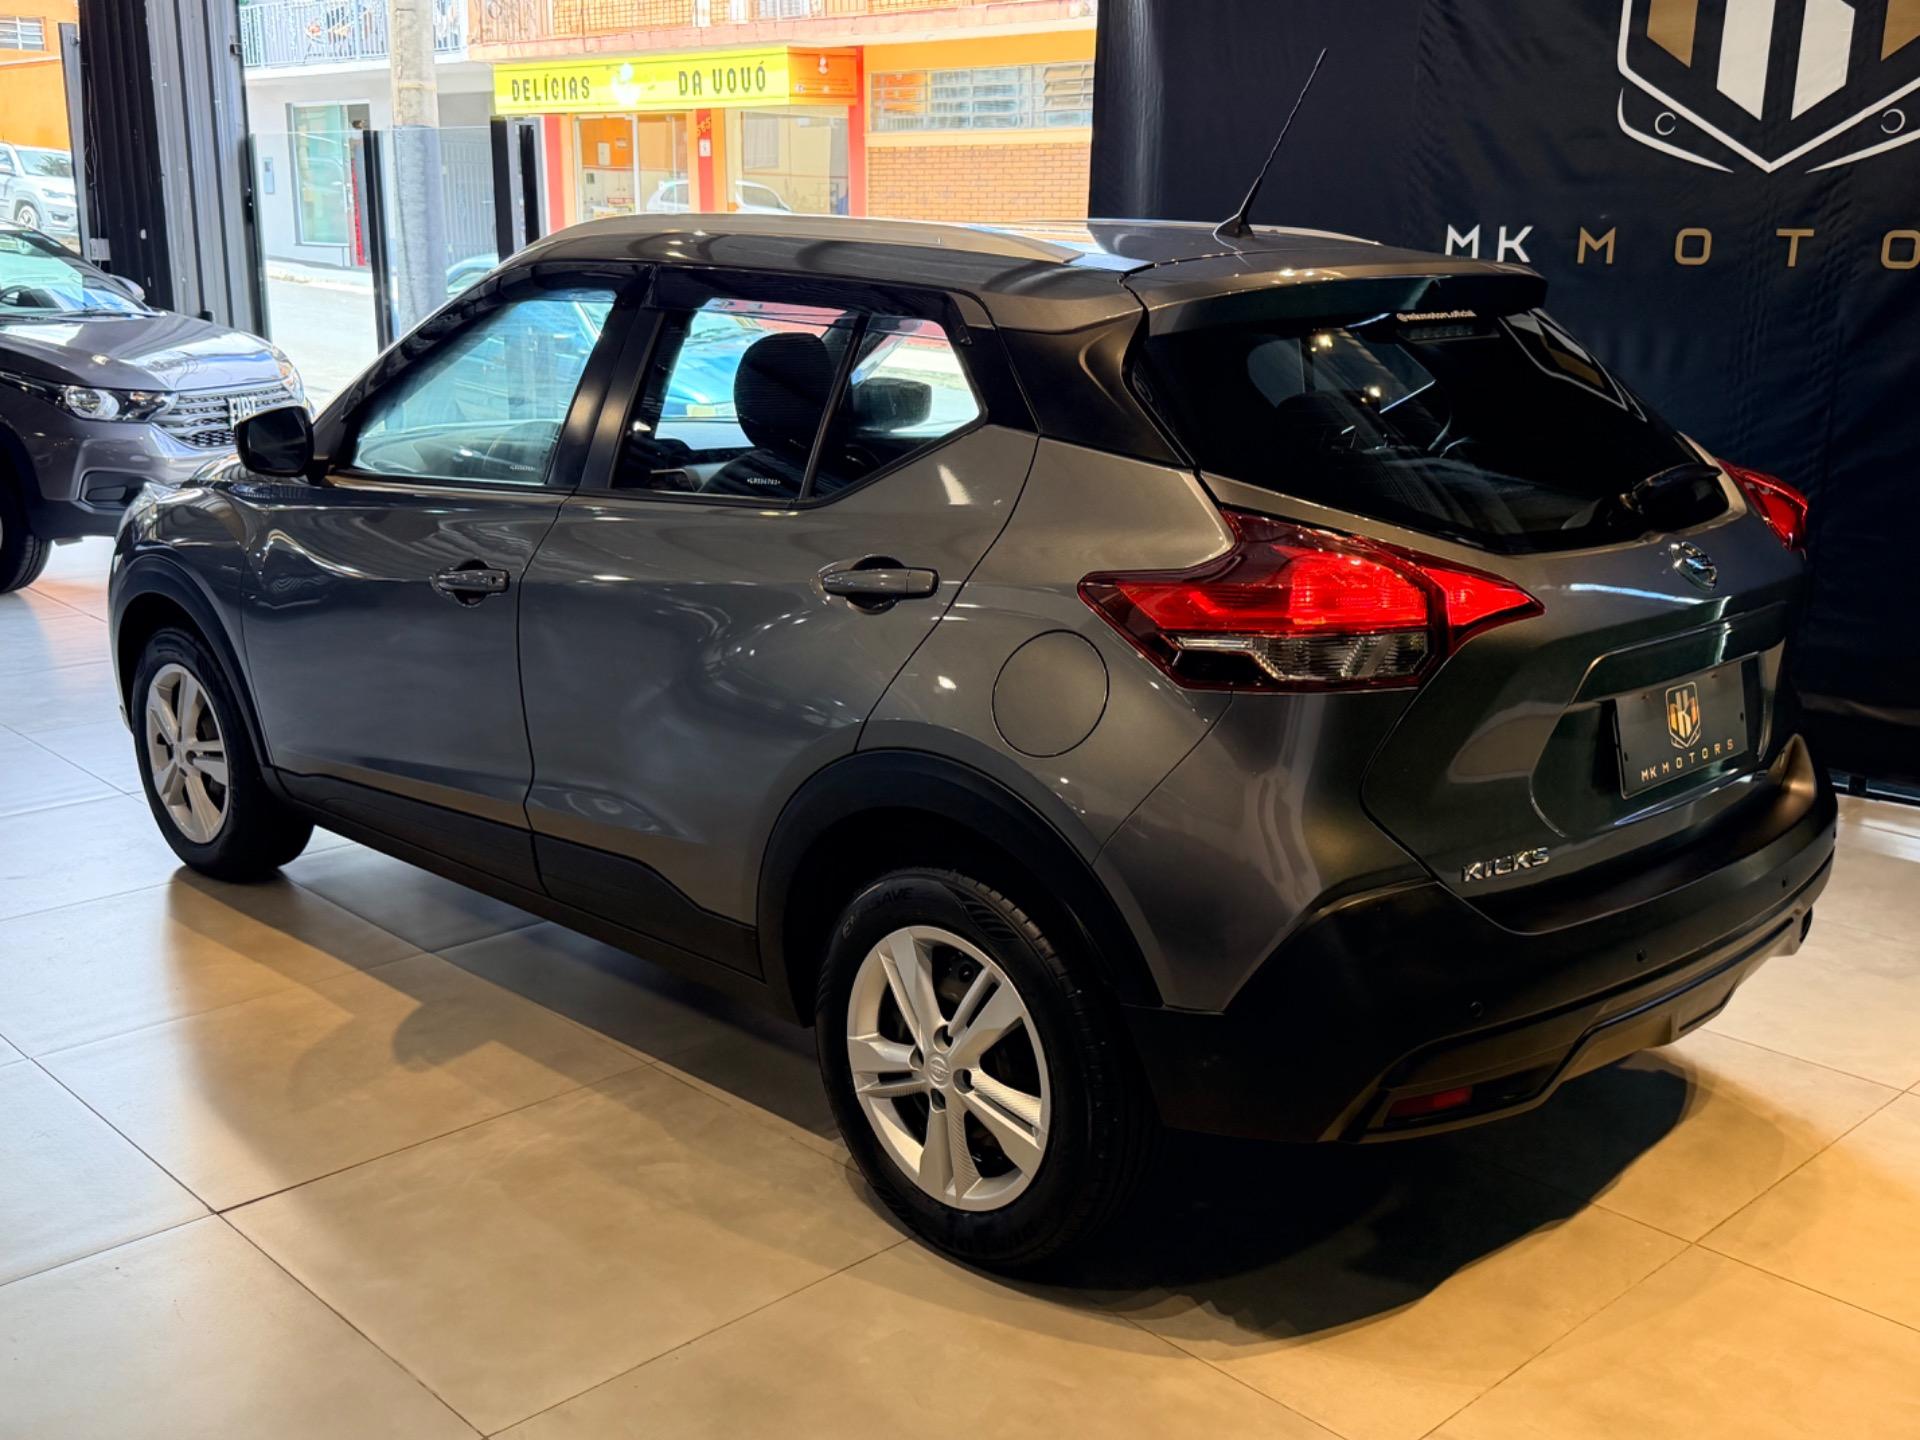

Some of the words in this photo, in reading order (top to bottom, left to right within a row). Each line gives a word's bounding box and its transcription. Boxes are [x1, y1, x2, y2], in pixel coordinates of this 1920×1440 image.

[511, 74, 590, 101] DELÍCIAS
[678, 70, 702, 96] DA
[1444, 223, 1534, 263] MK
[228, 396, 257, 431] FIAT
[1463, 846, 1550, 882] KICKS
